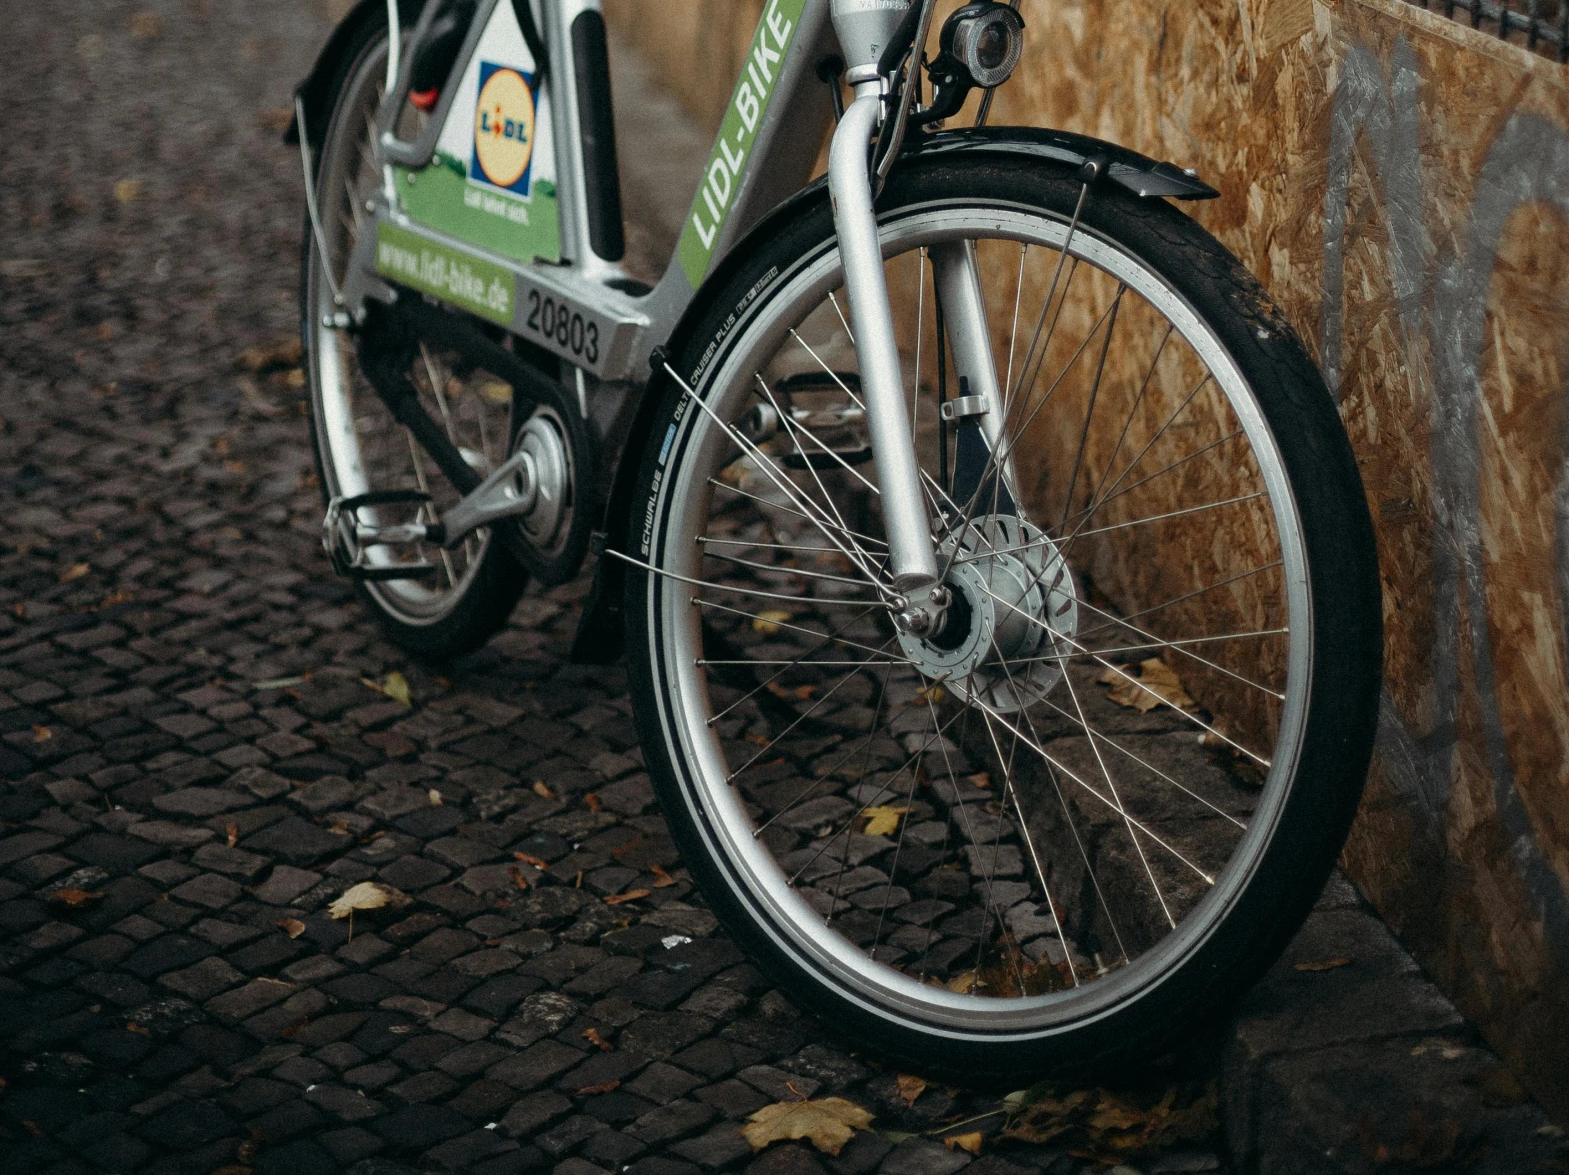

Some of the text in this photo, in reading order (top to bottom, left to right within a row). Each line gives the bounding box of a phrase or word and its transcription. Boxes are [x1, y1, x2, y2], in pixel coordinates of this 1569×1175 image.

[526, 288, 600, 365] 20803
[641, 469, 662, 557] SCHWALBE
[690, 341, 717, 386] CRUISER
[715, 313, 736, 343] PLUS
